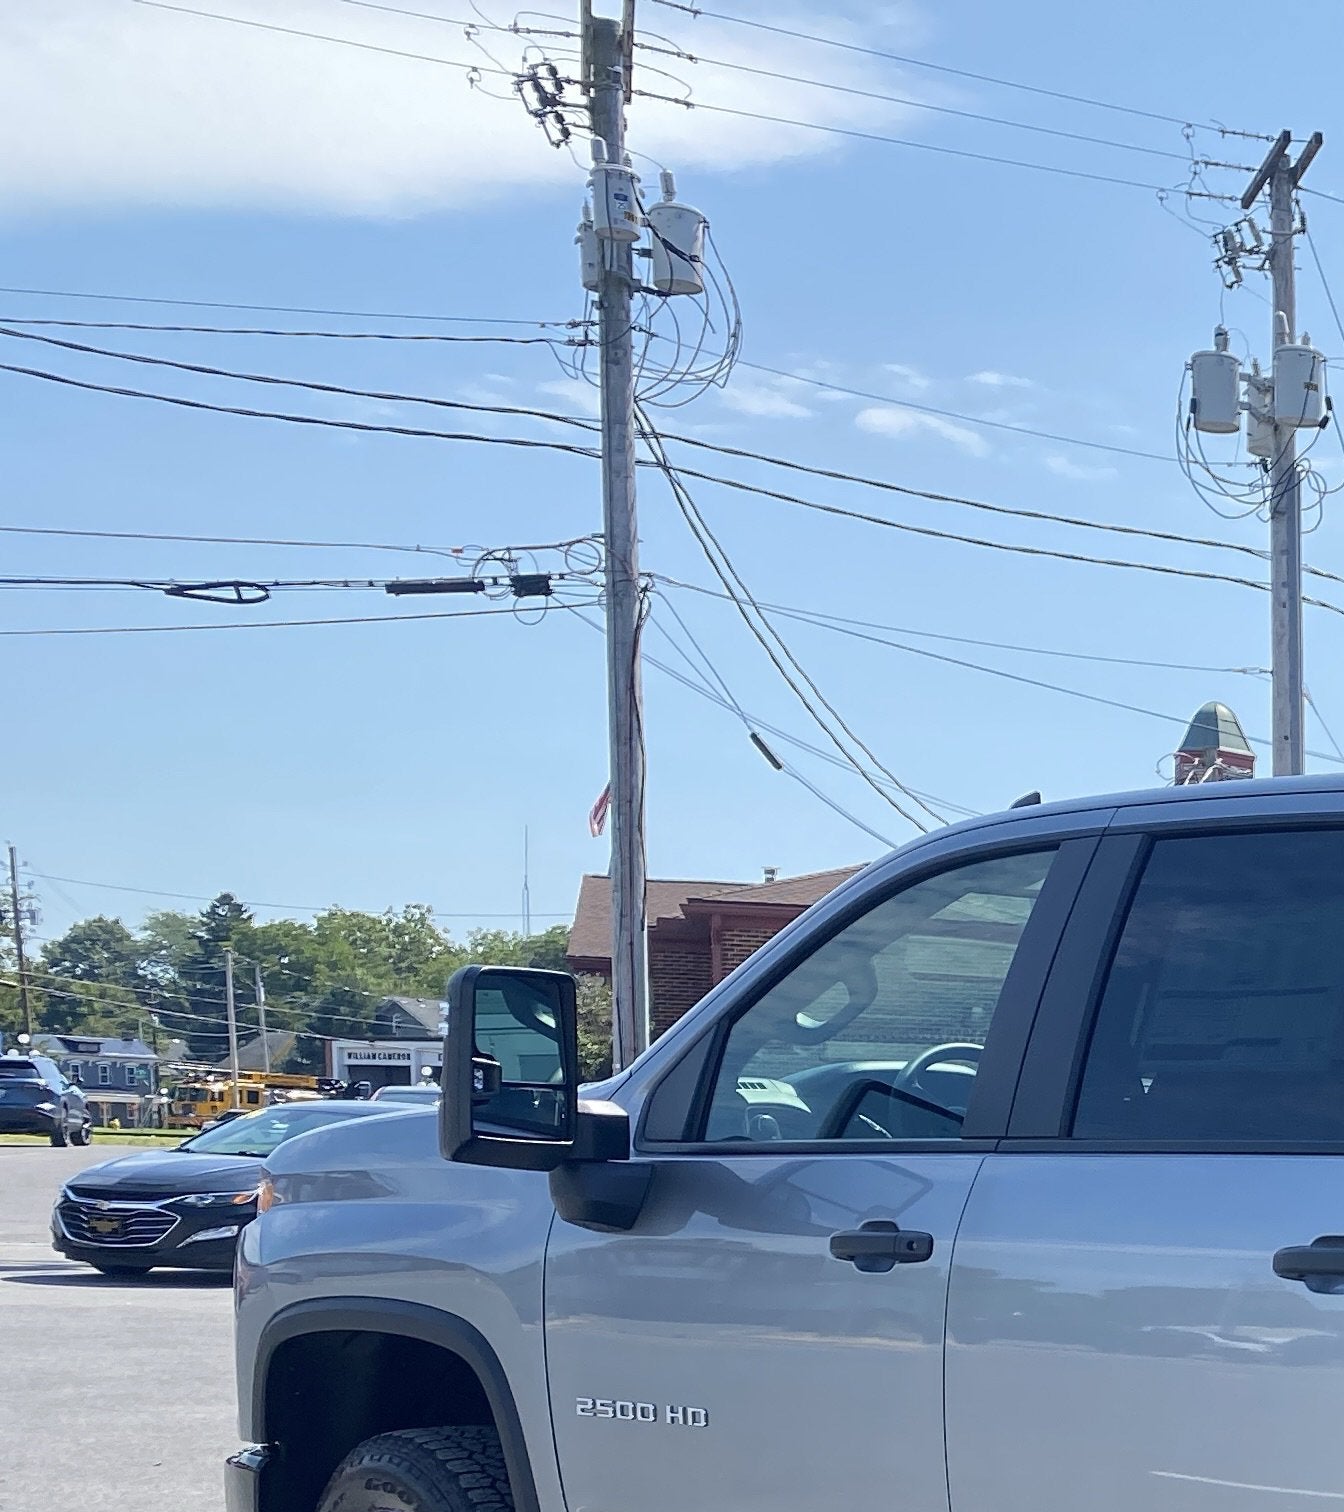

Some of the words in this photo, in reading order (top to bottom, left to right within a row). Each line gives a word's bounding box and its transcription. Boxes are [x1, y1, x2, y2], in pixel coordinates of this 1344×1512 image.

[347, 1051, 376, 1061] WILLIAM
[378, 1052, 411, 1061] CAMERON
[575, 1397, 657, 1423] 2500
[666, 1404, 709, 1427] HD
